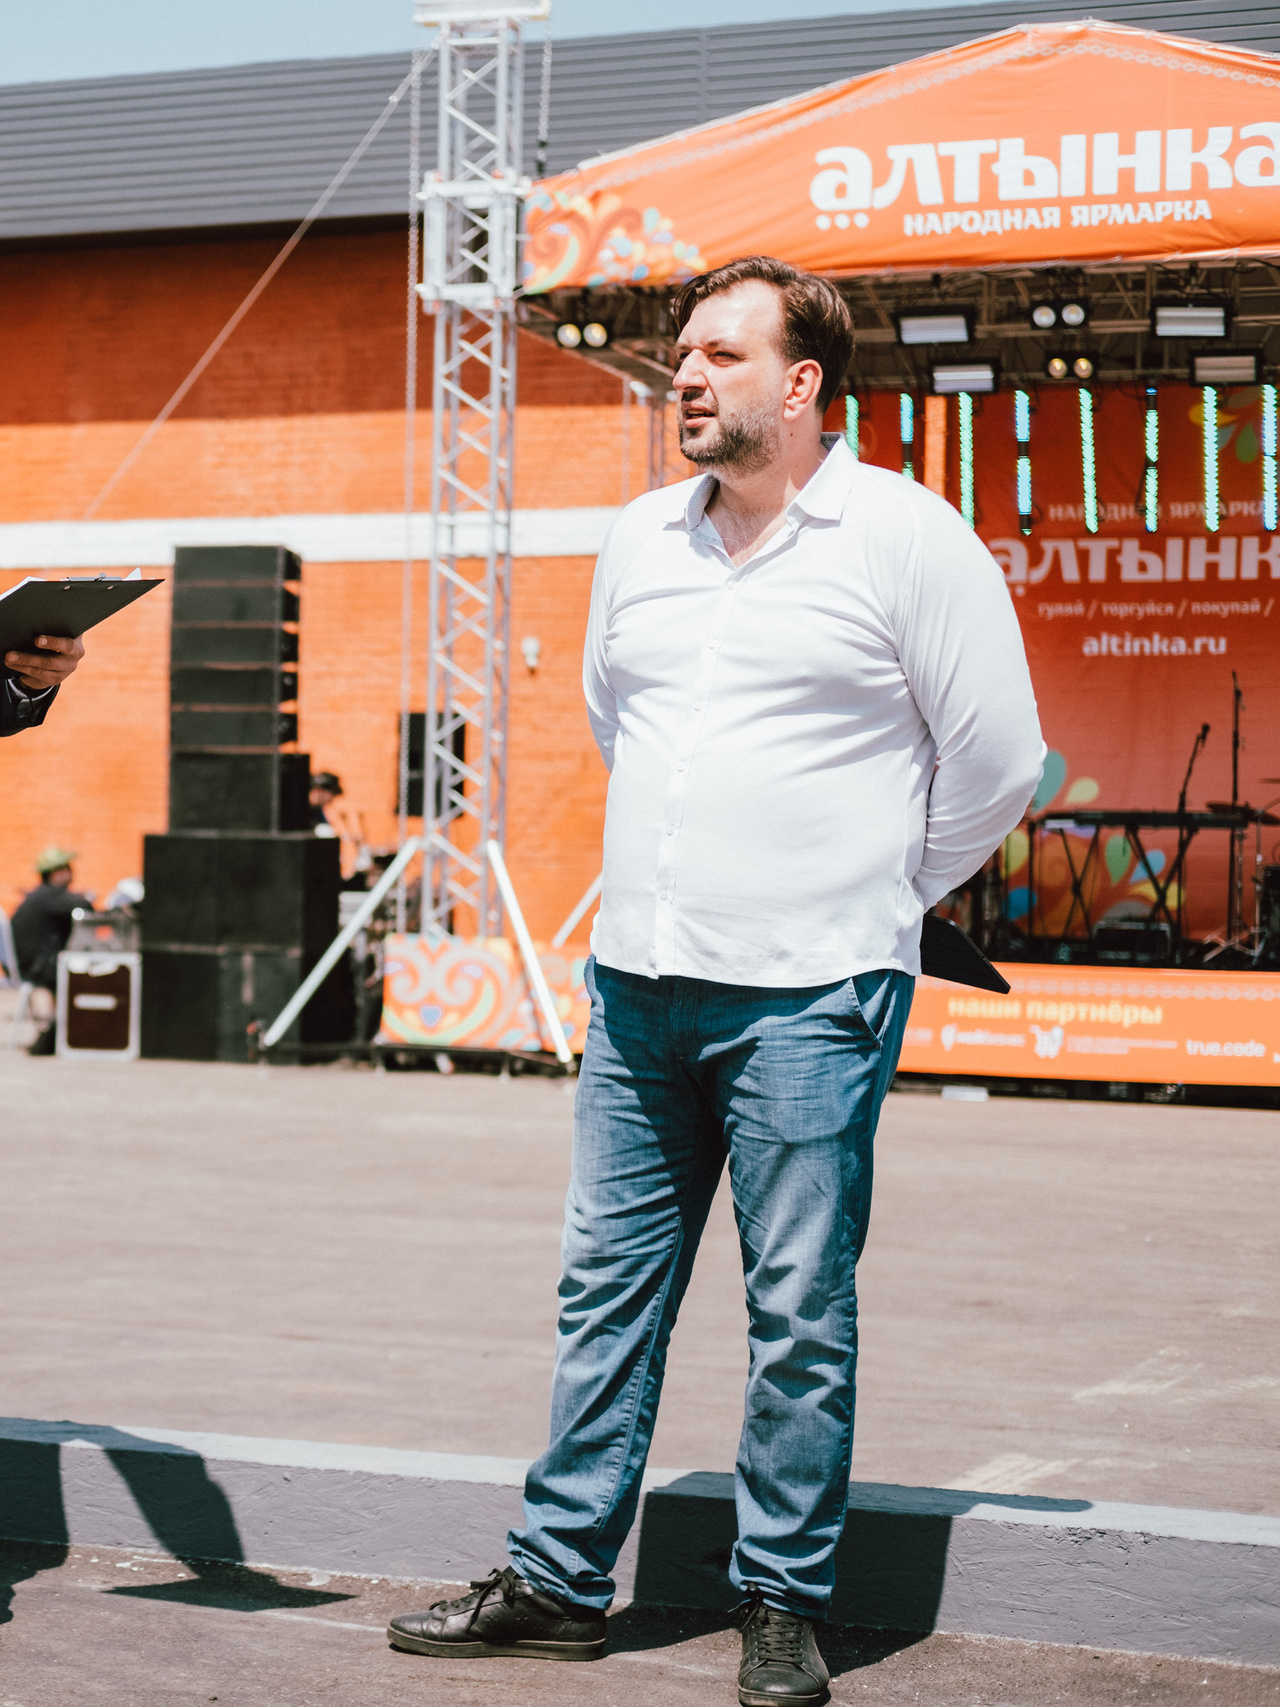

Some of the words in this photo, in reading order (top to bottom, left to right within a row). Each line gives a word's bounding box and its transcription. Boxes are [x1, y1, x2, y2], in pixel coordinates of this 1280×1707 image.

[904, 206, 1061, 236] НАРОДНАЯ
[1071, 200, 1212, 227] ЯРМАРКА
[1038, 600, 1084, 619] гуляй
[1102, 599, 1174, 619] торгуйся
[1191, 598, 1260, 618] покупай
[1082, 632, 1227, 656] altinka.ru
[1026, 1000, 1162, 1028] партнёры
[1186, 1038, 1266, 1057] true.code
